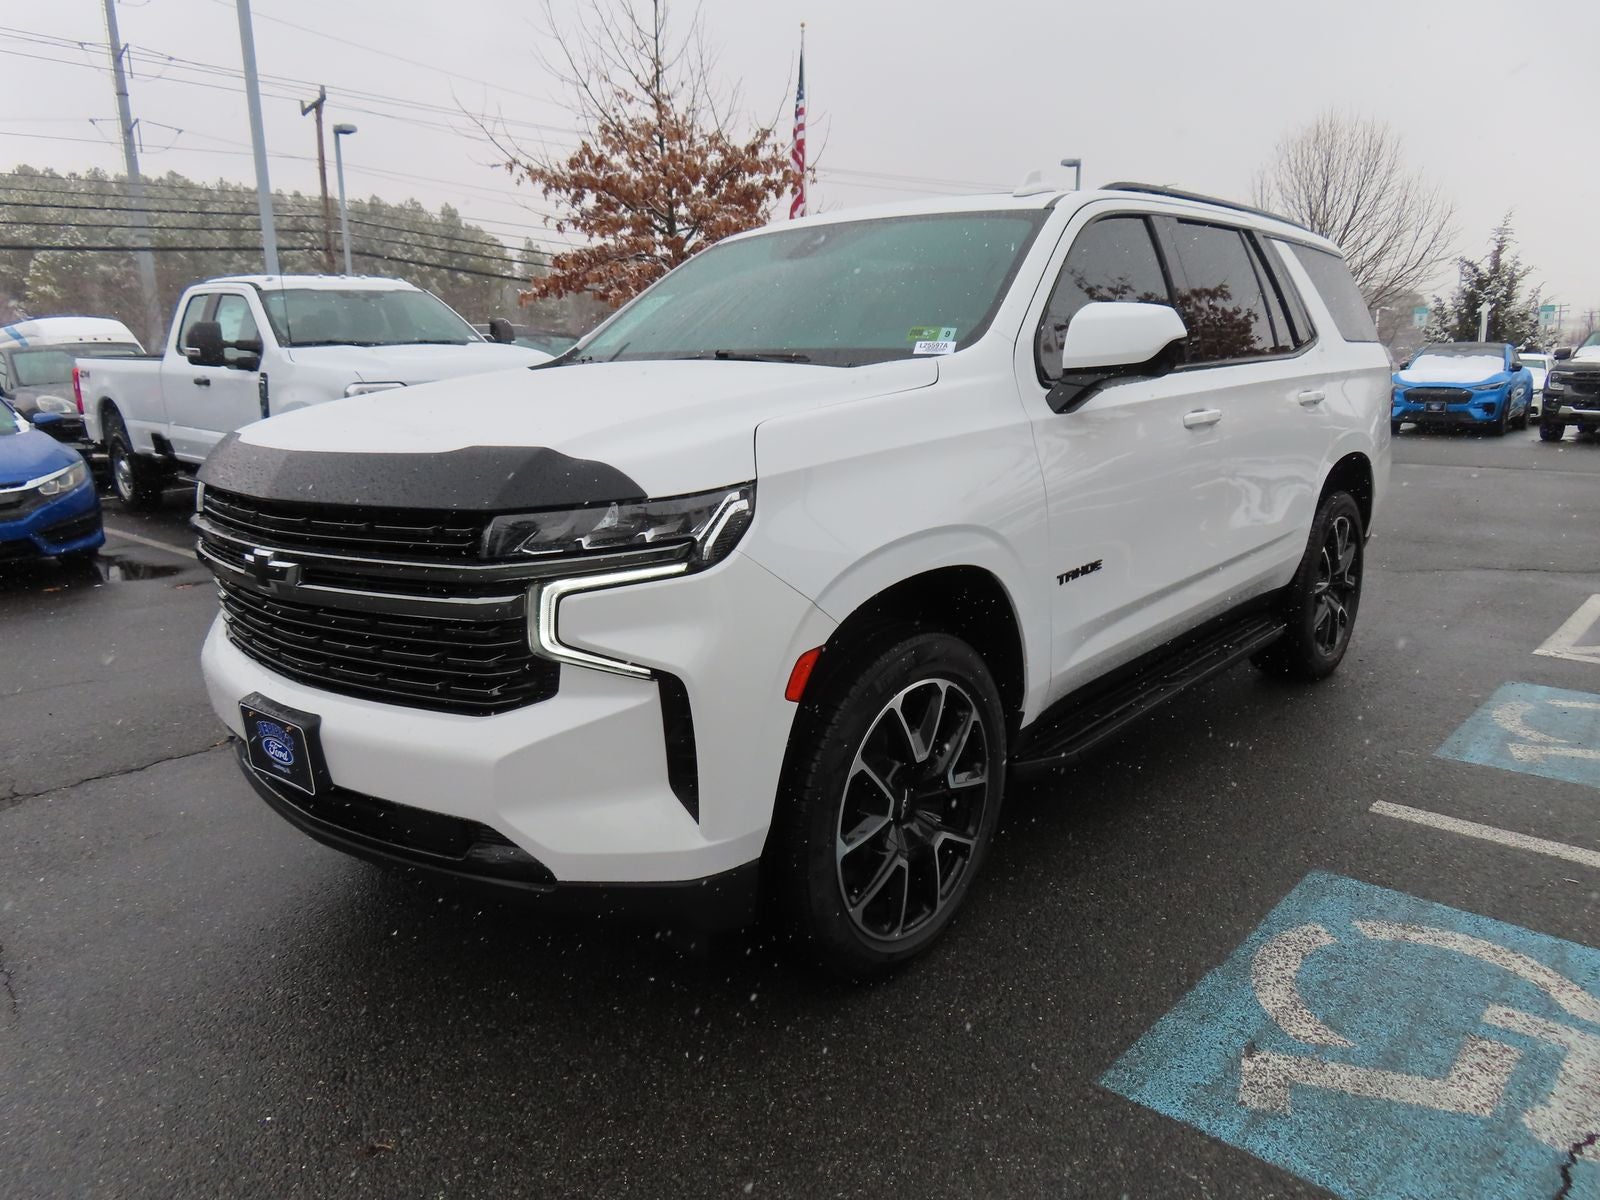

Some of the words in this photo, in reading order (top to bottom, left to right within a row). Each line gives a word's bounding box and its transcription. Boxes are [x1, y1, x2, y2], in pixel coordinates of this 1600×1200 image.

[945, 330, 951, 338] 9
[1056, 559, 1103, 586] TAHOE
[268, 740, 289, 762] Ford
